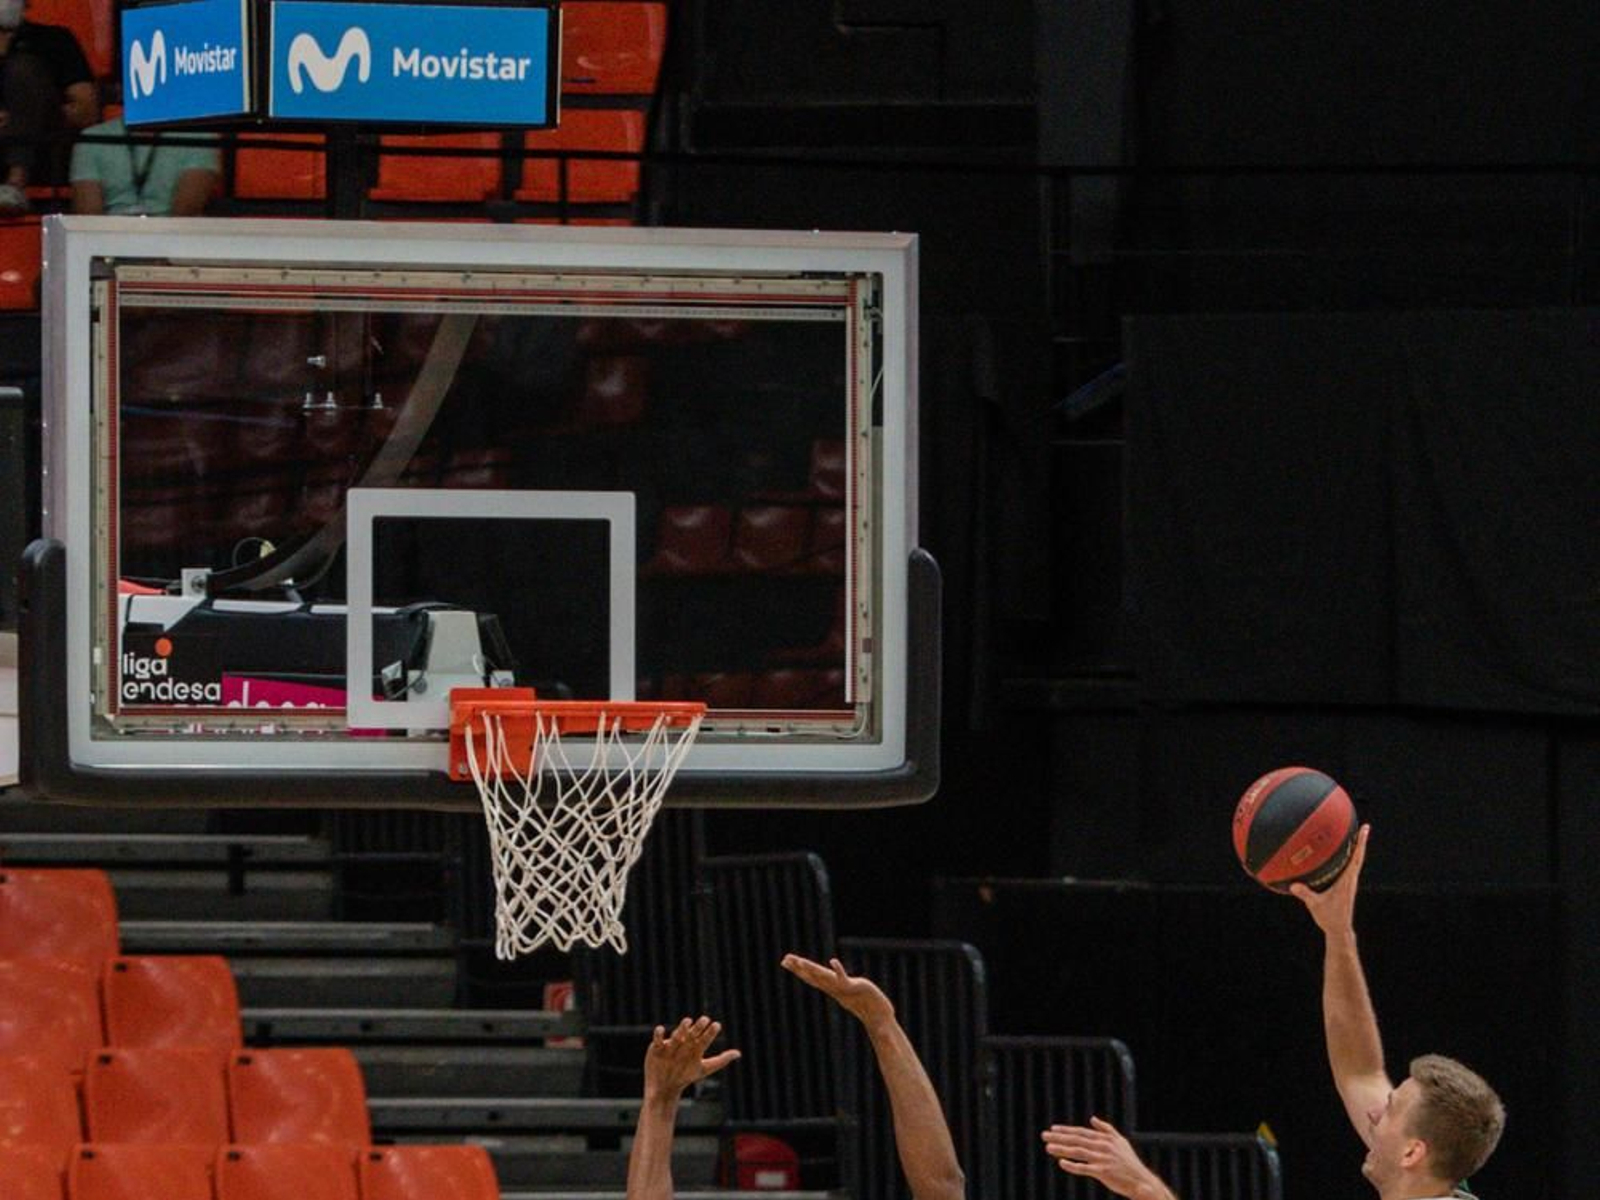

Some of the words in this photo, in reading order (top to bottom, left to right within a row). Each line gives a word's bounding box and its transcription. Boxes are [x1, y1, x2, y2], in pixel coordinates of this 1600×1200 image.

[174, 43, 237, 77] Movistar
[392, 46, 532, 81] Movistar
[122, 651, 168, 680] liga
[122, 677, 222, 700] endesa
